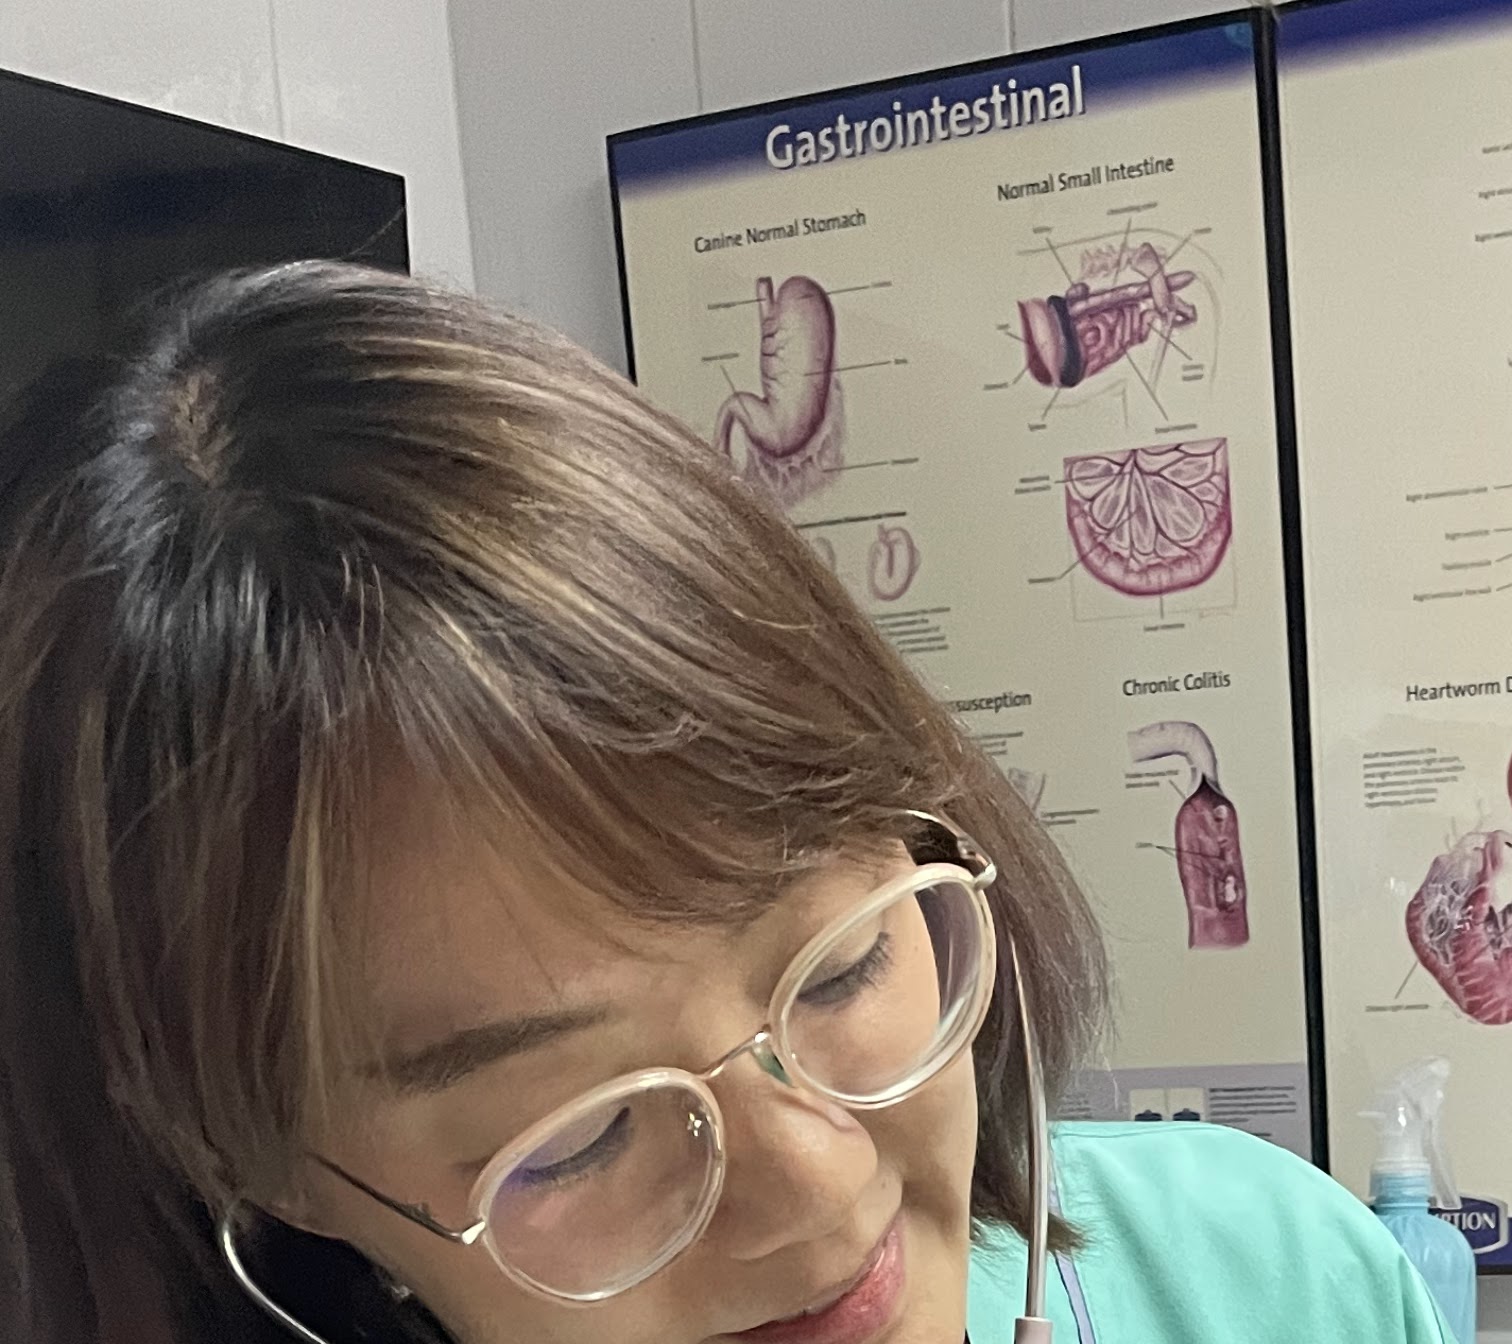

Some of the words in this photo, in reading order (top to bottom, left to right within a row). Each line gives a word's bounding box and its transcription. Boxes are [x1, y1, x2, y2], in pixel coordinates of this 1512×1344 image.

[765, 65, 1086, 169] Gastrointestinal
[998, 173, 1055, 202] Normal
[1058, 165, 1102, 191] Small
[1105, 155, 1174, 185] Intestine
[694, 229, 743, 254] Canine
[746, 217, 801, 245] Normal
[802, 207, 867, 236] Stomach
[1122, 674, 1181, 697] Chronic
[1183, 670, 1232, 693] Colitis
[1405, 676, 1502, 703] Heartworm
